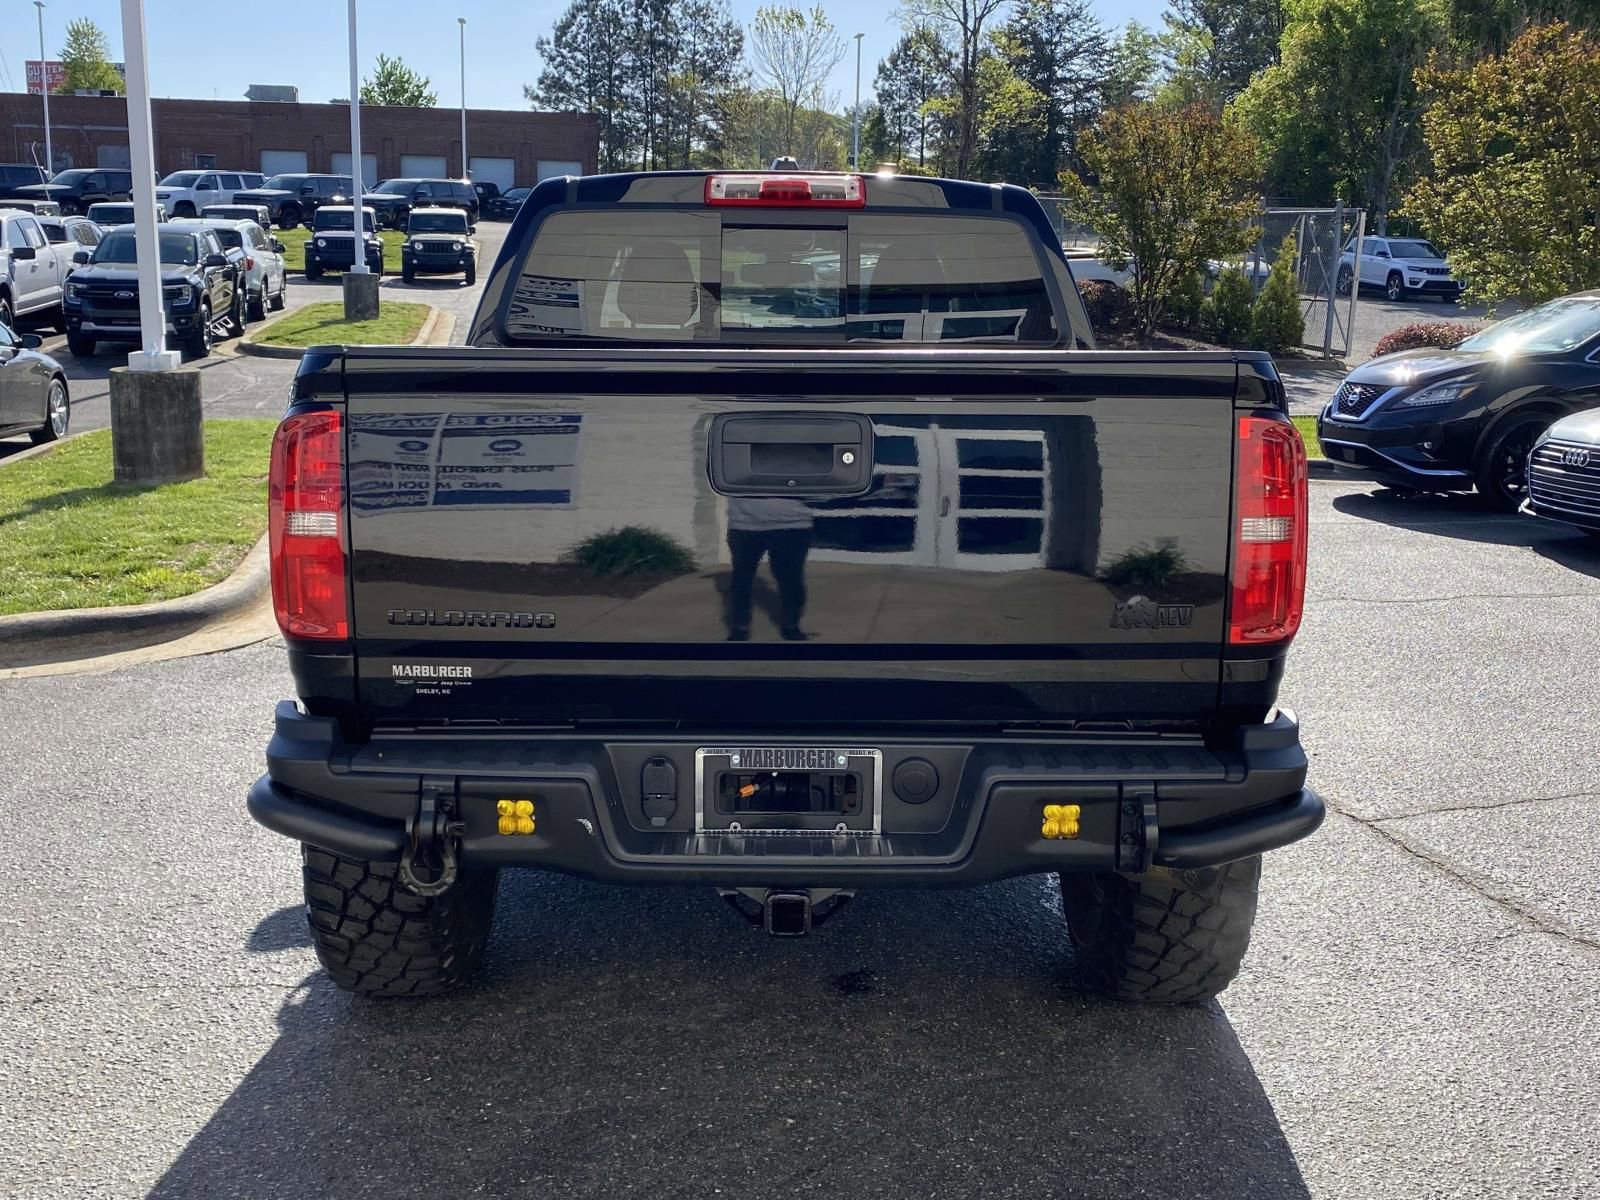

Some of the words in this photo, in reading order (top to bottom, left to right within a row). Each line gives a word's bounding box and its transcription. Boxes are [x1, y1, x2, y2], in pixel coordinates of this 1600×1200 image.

[387, 608, 557, 629] COLORADO
[1156, 606, 1193, 626] AEV
[392, 664, 473, 678] MARBURGER
[415, 688, 441, 696] SHELBY,
[740, 748, 836, 769] MARBURGER
